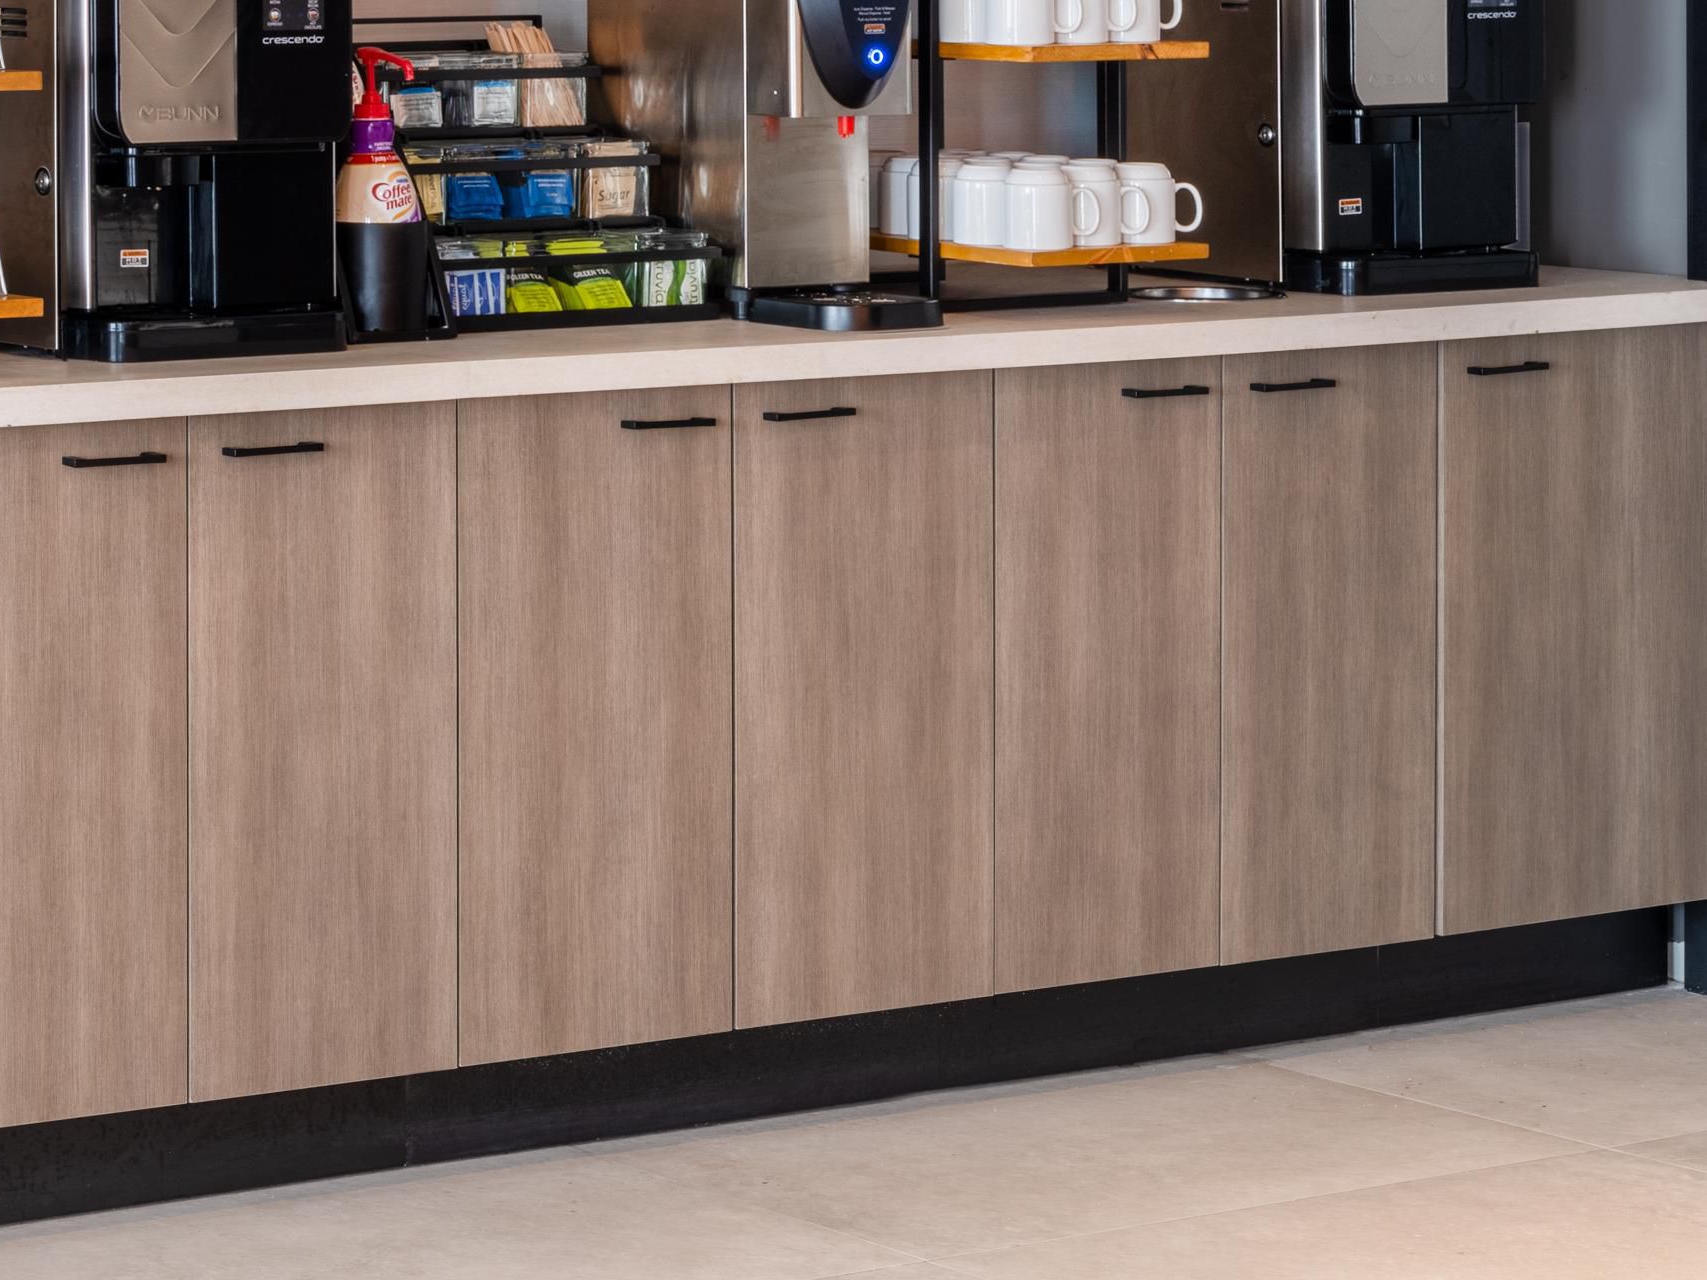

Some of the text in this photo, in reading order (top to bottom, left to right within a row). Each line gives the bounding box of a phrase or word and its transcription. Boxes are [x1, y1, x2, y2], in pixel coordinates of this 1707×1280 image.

[1467, 10, 1516, 20] crescendo
[262, 35, 324, 44] crescendo
[156, 106, 219, 121] BUNN
[371, 182, 411, 202] Coffee
[598, 189, 631, 205] Sugar
[386, 194, 412, 210] mate
[574, 268, 612, 279] GREEN TEA
[461, 282, 471, 311] equal
